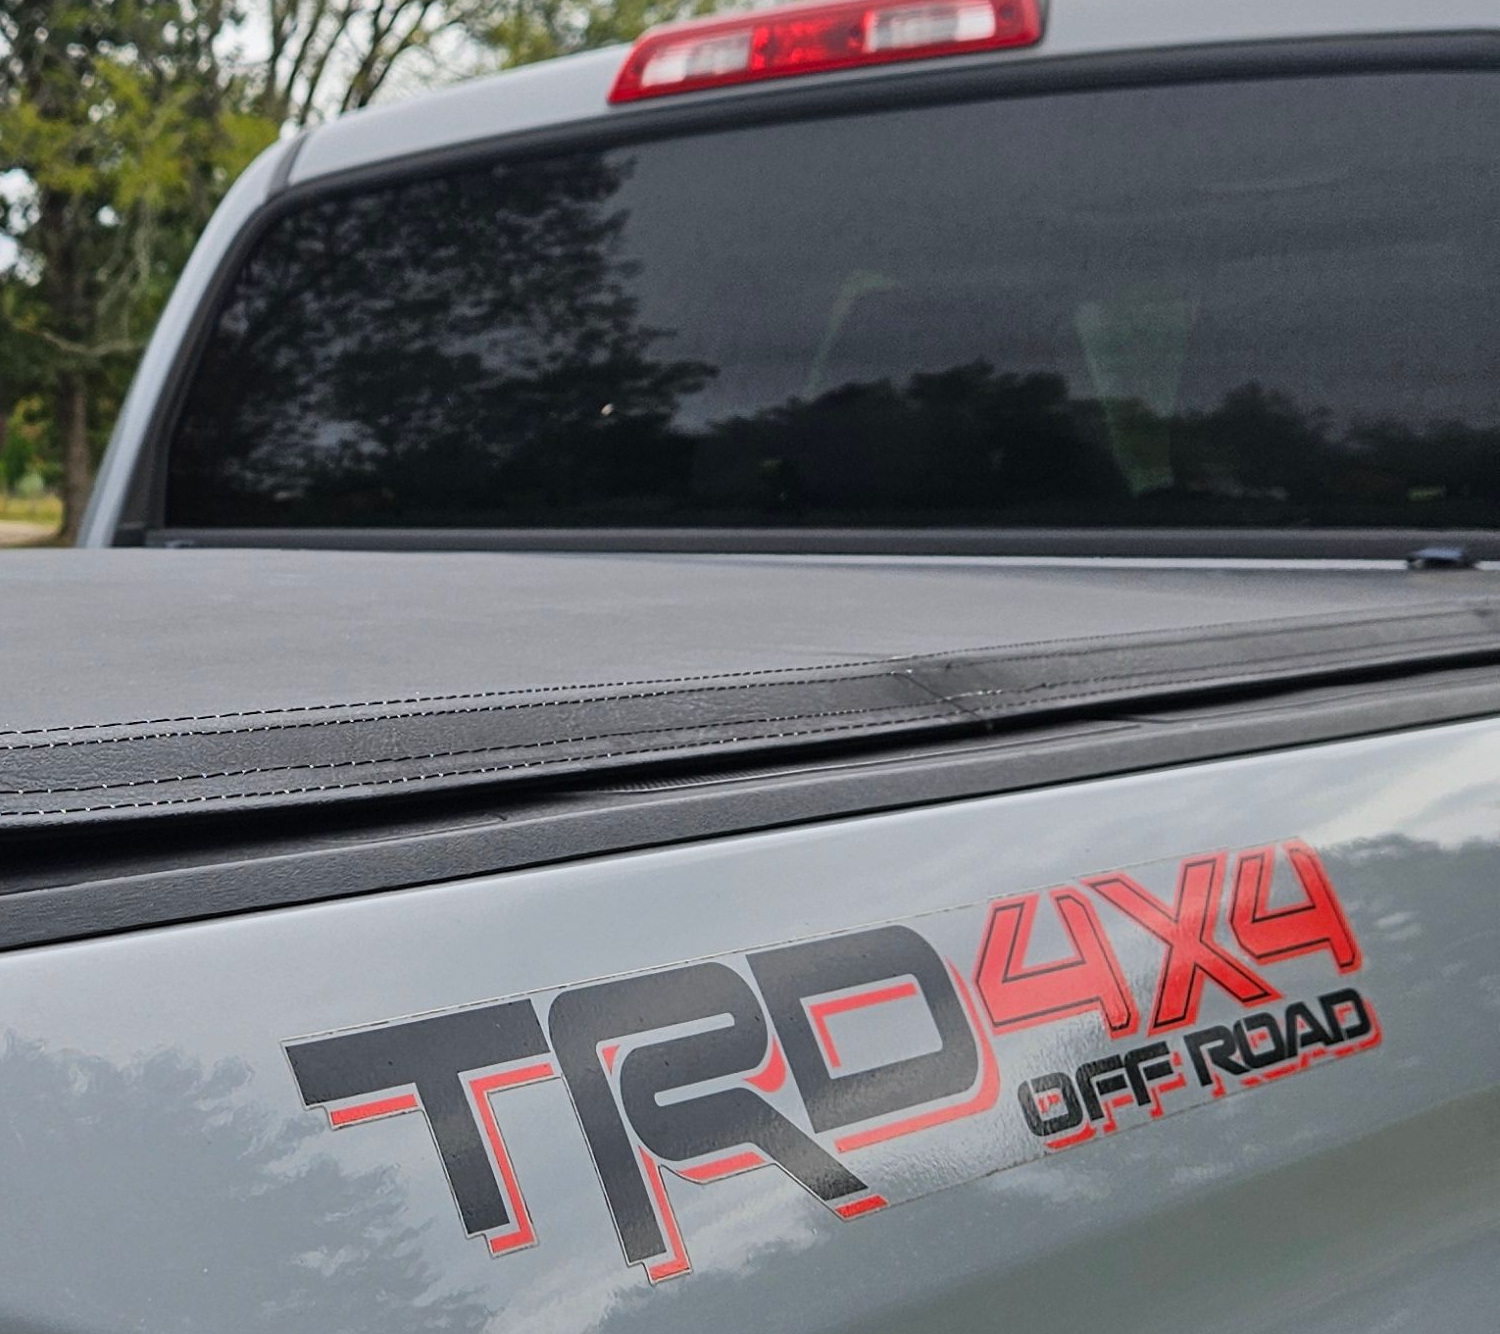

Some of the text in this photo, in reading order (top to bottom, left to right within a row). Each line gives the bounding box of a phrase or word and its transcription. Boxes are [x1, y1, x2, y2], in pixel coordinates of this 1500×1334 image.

[283, 839, 1362, 1283] TRD 4X4
[1017, 987, 1382, 1149] OFF ROAD
